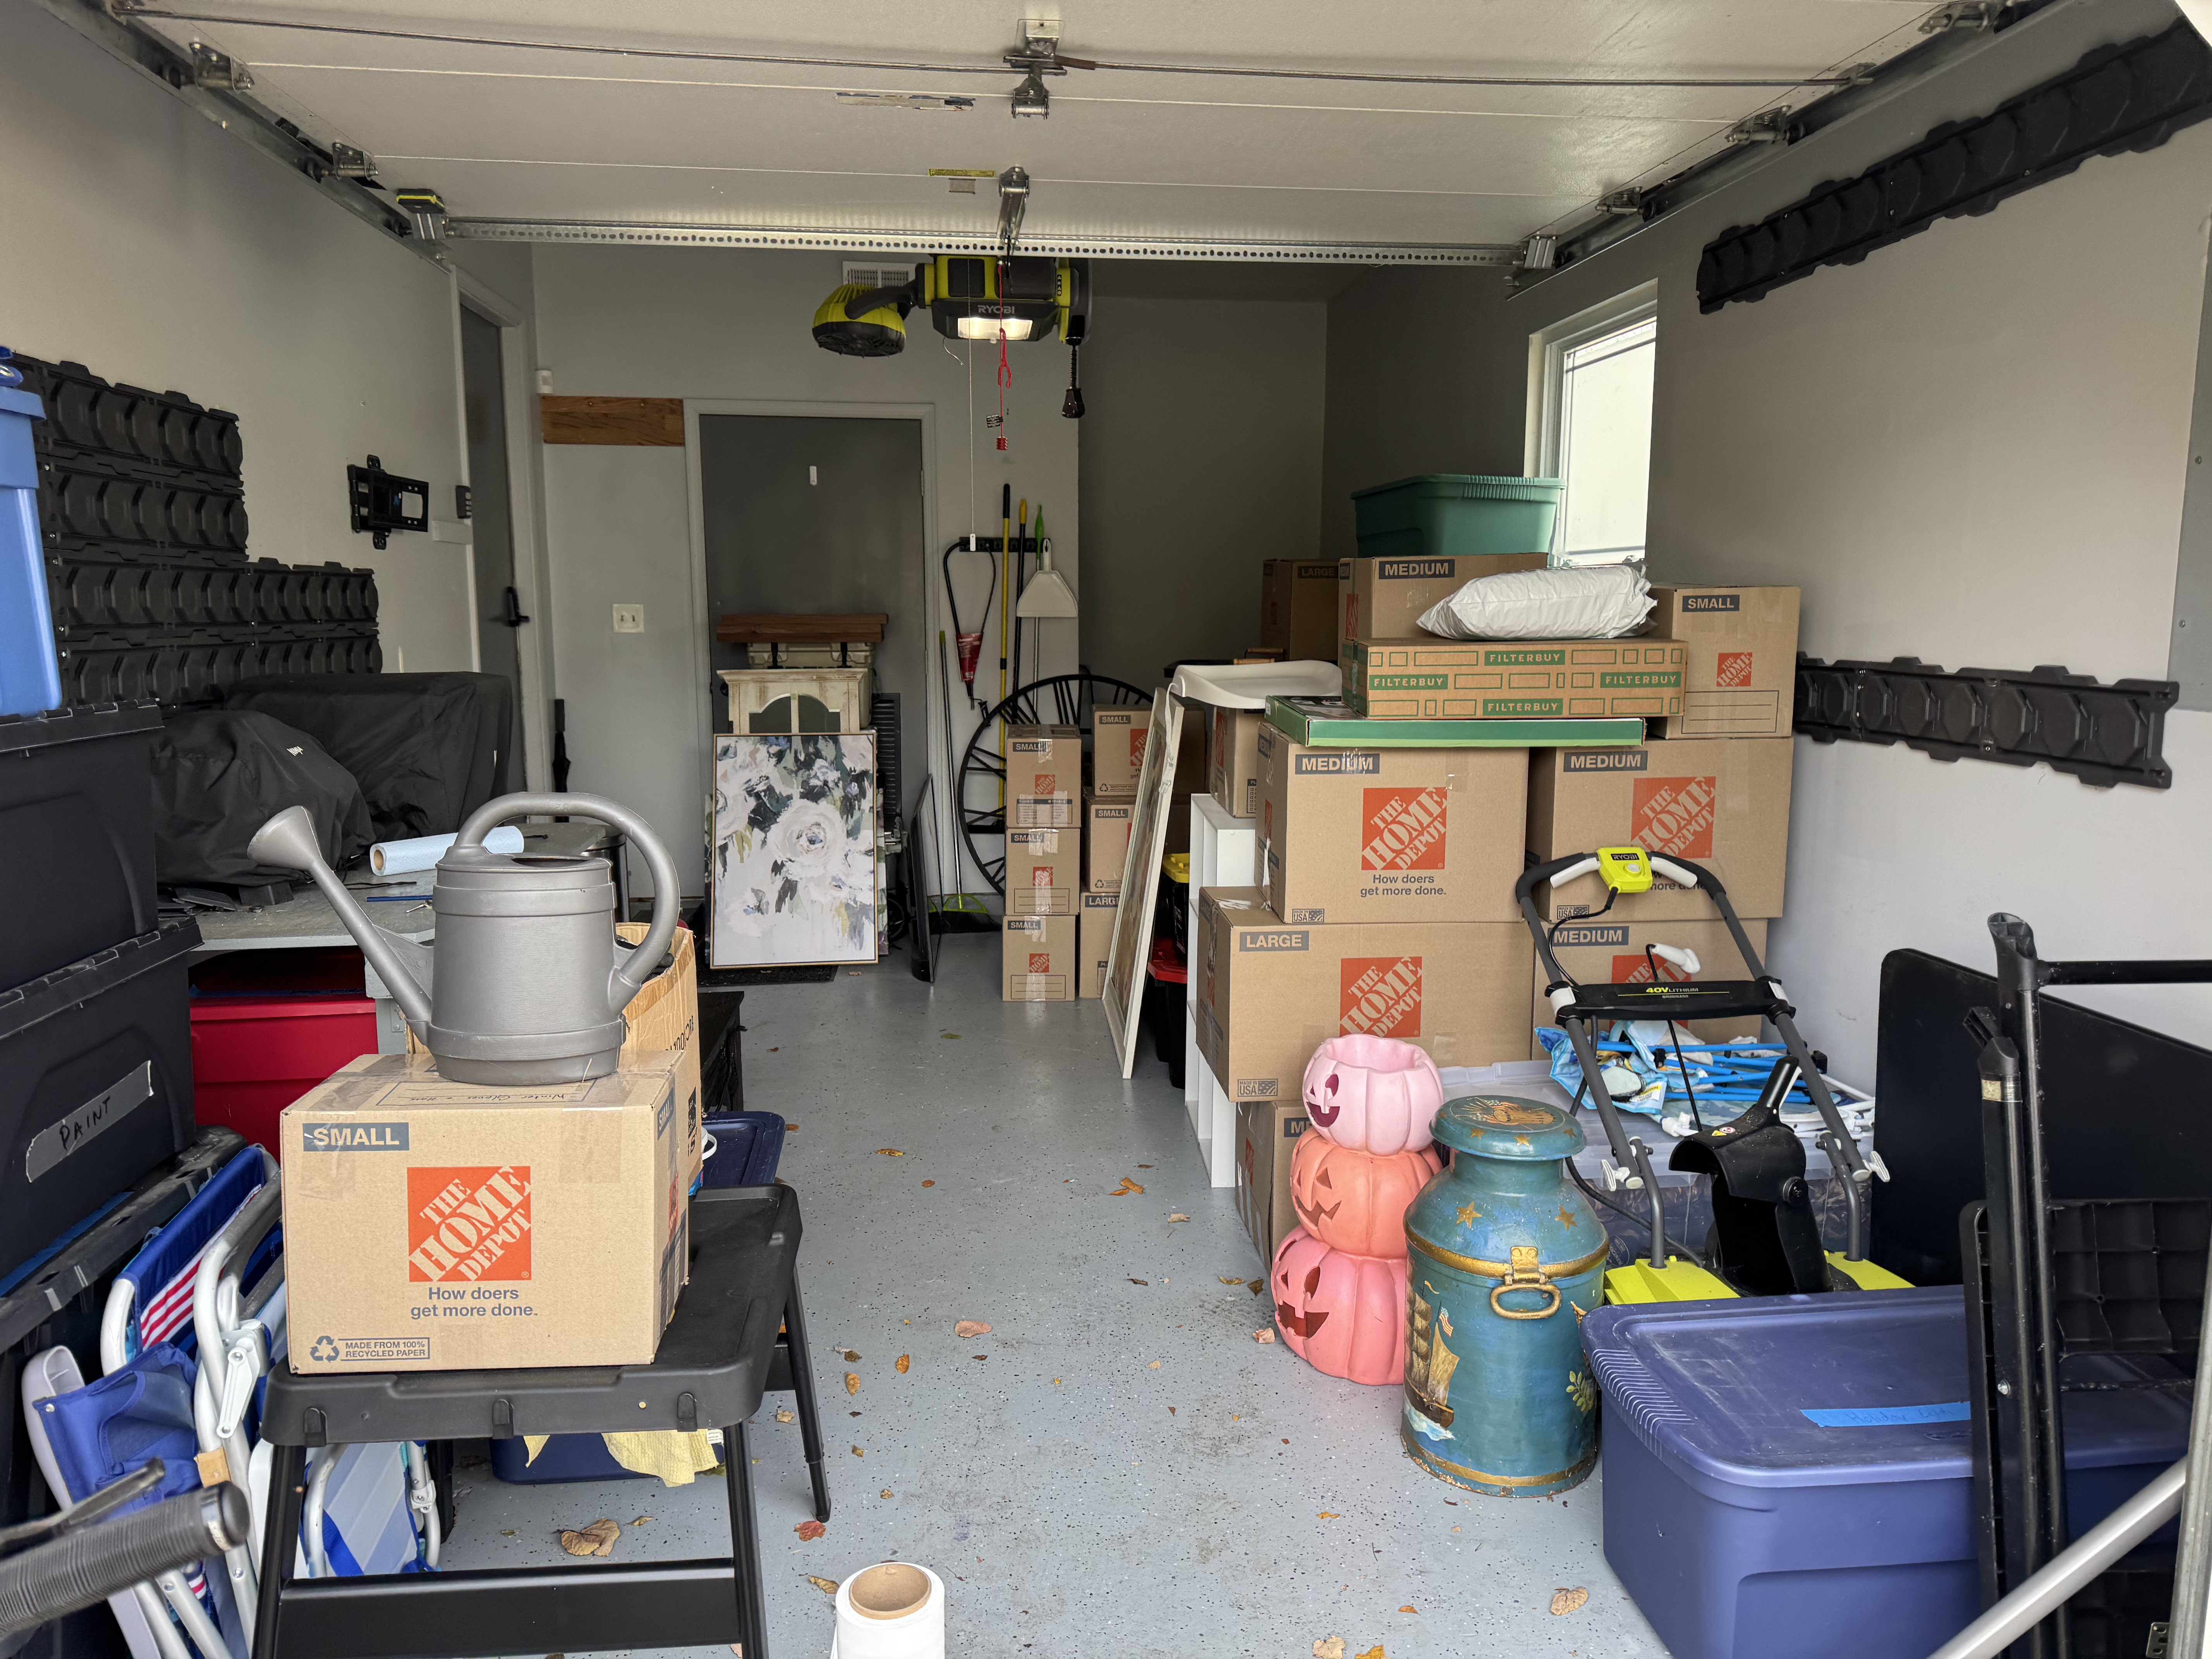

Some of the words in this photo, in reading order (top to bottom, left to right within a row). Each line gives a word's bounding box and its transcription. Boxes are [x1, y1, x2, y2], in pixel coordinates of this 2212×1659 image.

[978, 304, 1015, 314] RYOBI
[1302, 568, 1335, 576] LARGE
[1385, 563, 1449, 576] MEDIUM
[1688, 598, 1735, 609] SMALL
[1490, 654, 1561, 663] FILTERBUY
[1717, 652, 1752, 687] HOME
[1374, 678, 1444, 687] FILTERBUY
[1606, 675, 1677, 685] FILTERBUY
[1488, 702, 1559, 712] FILTERBUY
[1302, 756, 1373, 771] MEDIUM
[1571, 754, 1642, 769] MEDIUM
[1640, 785, 1676, 819] THE
[1370, 796, 1406, 830] THE
[1631, 776, 1716, 852] HOME
[1362, 787, 1448, 871] HOME
[1663, 807, 1714, 856] DEPOT
[1394, 817, 1446, 871] DEPOT
[1373, 874, 1398, 884] How
[1401, 874, 1434, 884] doers
[1360, 886, 1379, 898] get
[1559, 910, 1572, 919] USA
[1246, 934, 1302, 948] LARGE
[1554, 929, 1622, 944] MEDIUM
[1348, 966, 1382, 999] THE
[1340, 957, 1422, 1035] HOME
[1371, 986, 1422, 1037] DEPOT
[1240, 1085, 1257, 1095] USA
[59, 1096, 111, 1151] PAINT
[313, 1128, 400, 1147] SMALL
[419, 1178, 471, 1225] THE
[409, 1166, 531, 1282] HOME
[457, 1208, 532, 1282] DEPOT
[428, 1287, 466, 1300] How
[471, 1286, 519, 1300] doers
[410, 1304, 438, 1320] get
[443, 1306, 486, 1317] more
[345, 1350, 394, 1358] RECYCLED
